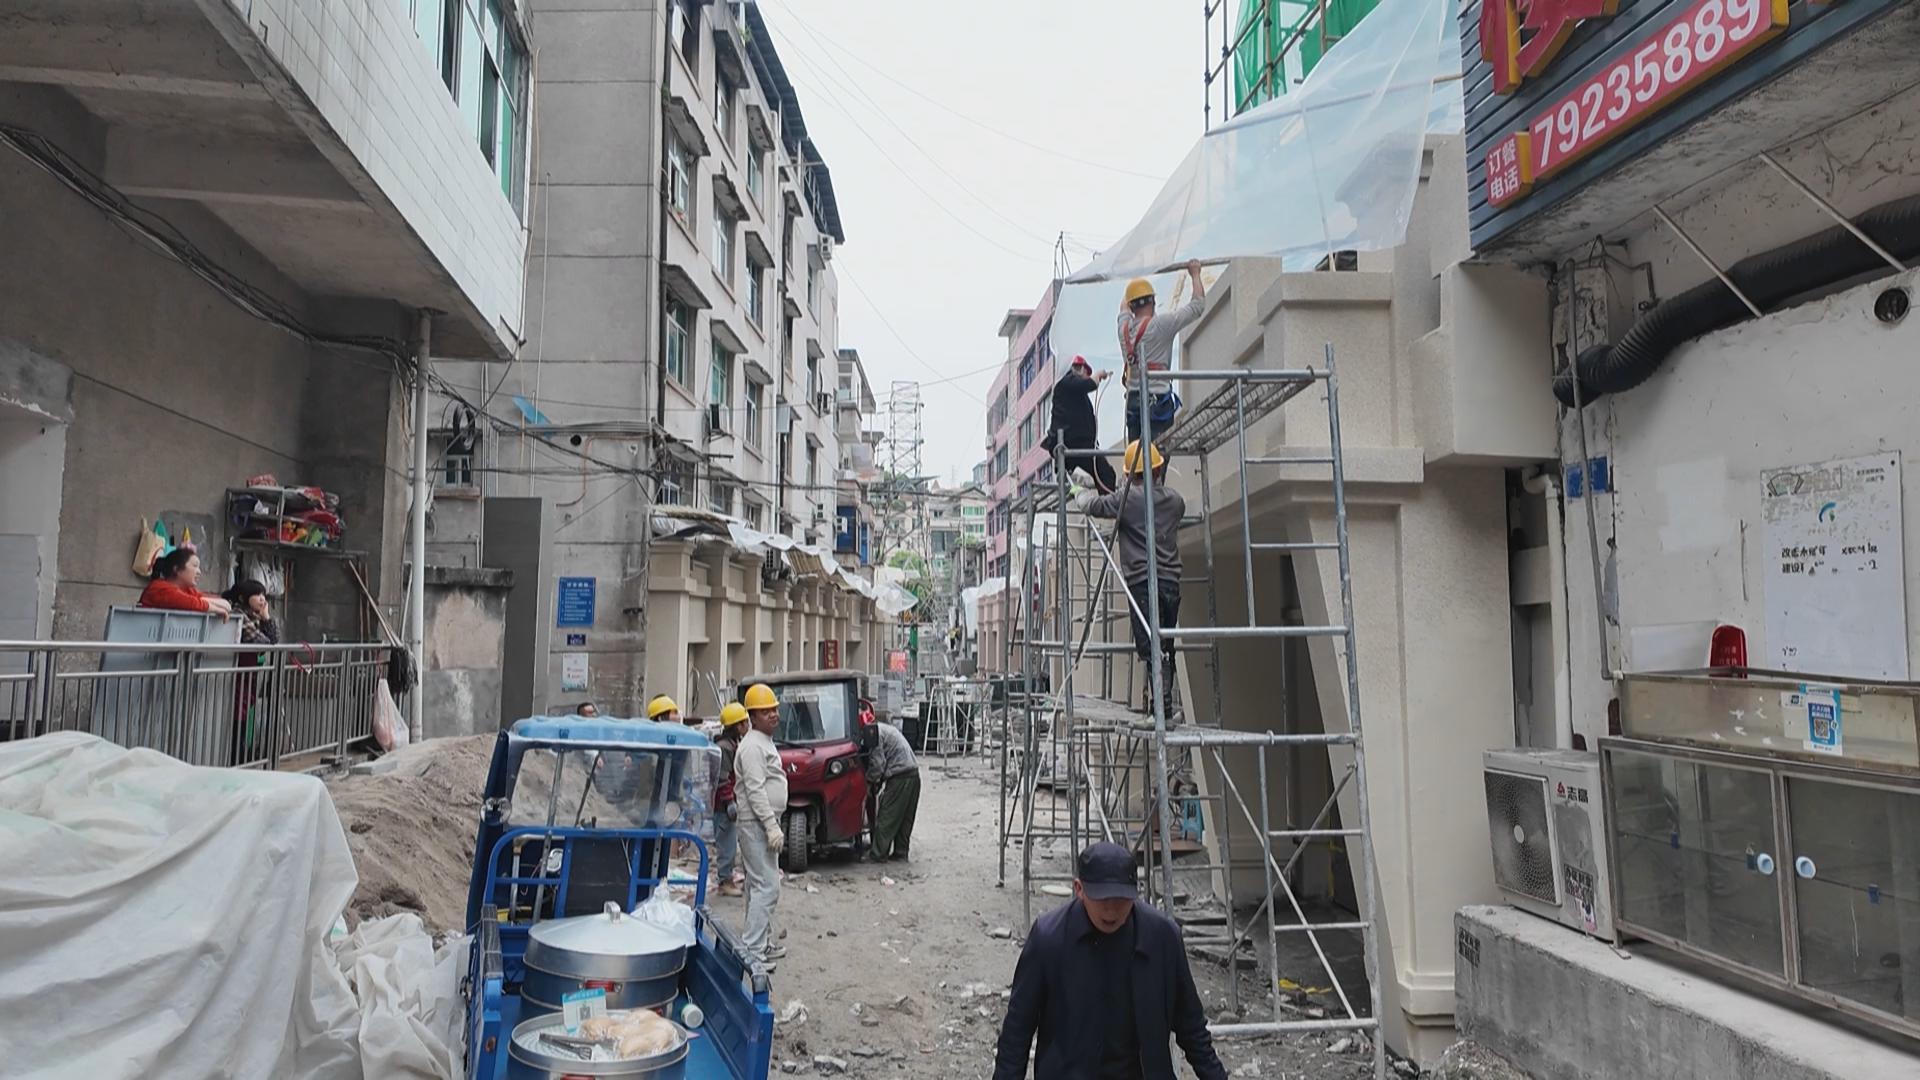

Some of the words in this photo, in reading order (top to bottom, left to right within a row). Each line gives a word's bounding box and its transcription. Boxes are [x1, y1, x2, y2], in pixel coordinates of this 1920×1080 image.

[1535, 0, 1760, 168] 79235889
[1488, 138, 1516, 176] 订餐
[1490, 167, 1519, 200] 电话
[1567, 786, 1588, 803] 志高
